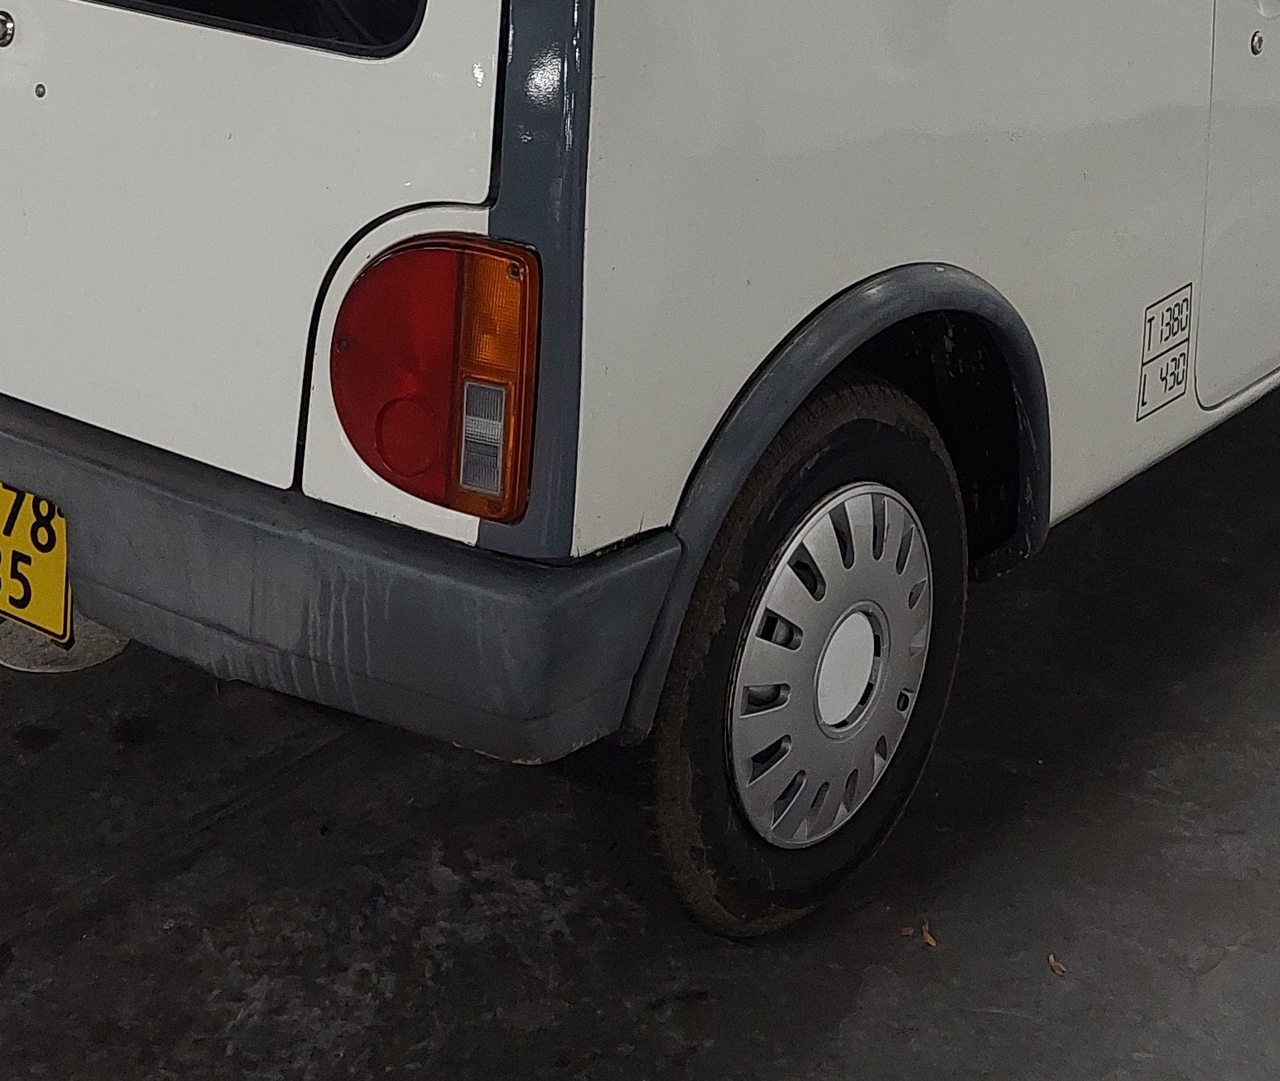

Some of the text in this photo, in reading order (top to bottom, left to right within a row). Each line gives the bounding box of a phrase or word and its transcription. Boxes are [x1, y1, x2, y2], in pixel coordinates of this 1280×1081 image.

[1147, 297, 1189, 351] T 1380
[1141, 352, 1186, 407] L 430
